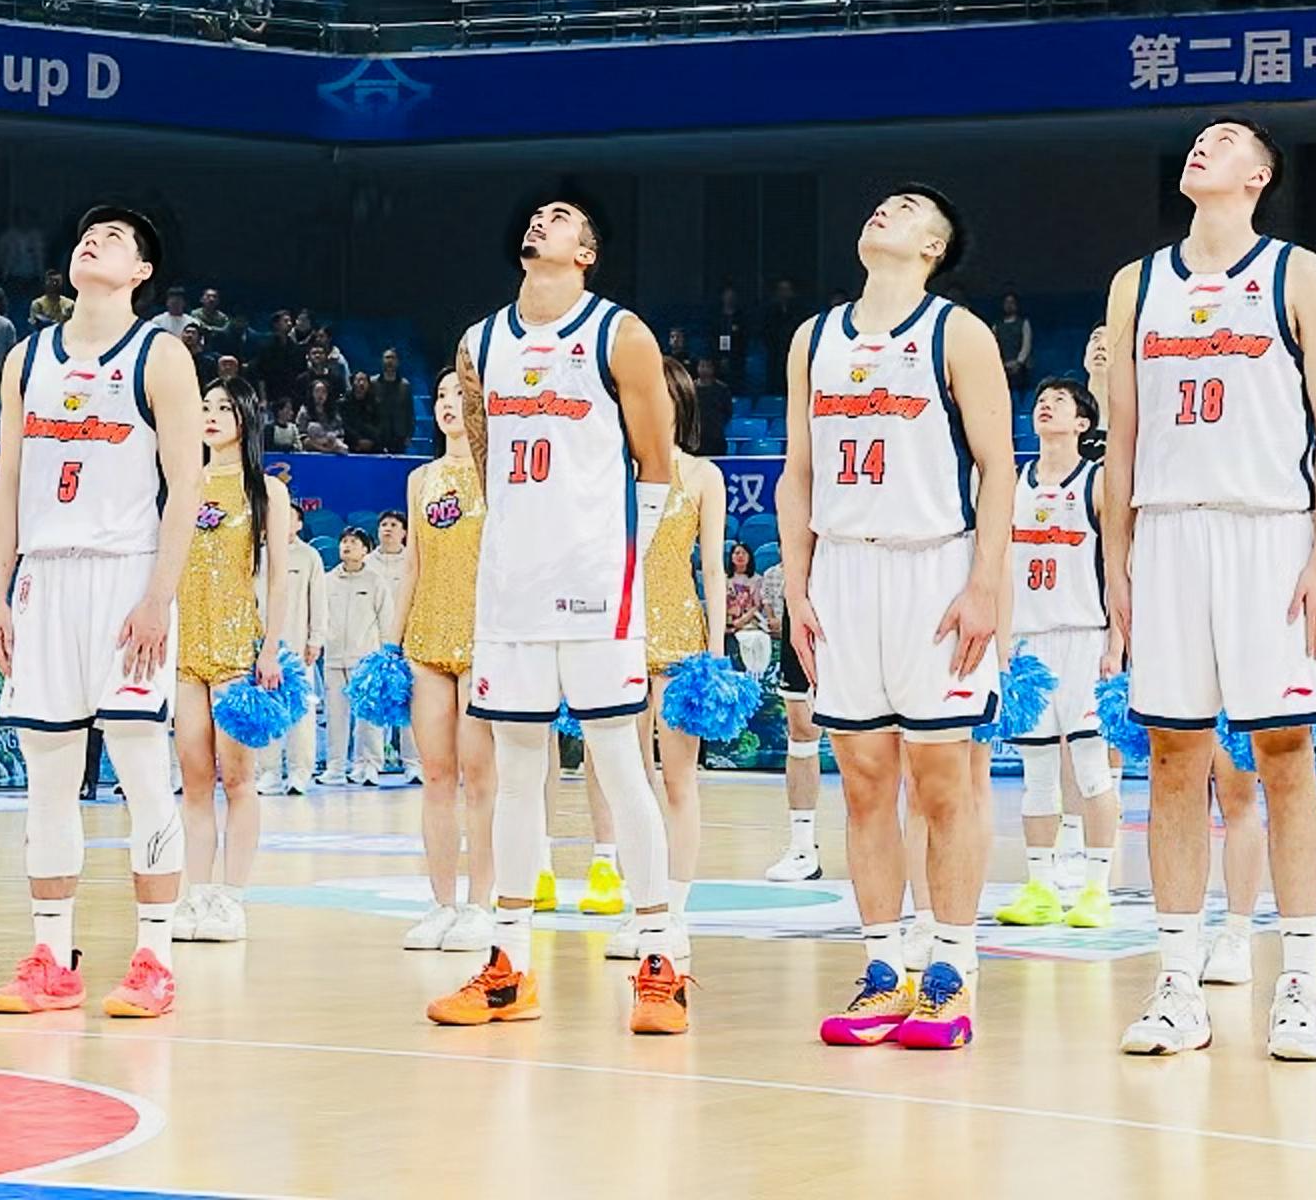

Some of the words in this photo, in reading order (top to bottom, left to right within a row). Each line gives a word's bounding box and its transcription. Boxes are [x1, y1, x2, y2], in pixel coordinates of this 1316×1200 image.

[88, 53, 121, 99] D
[1175, 377, 1225, 425] 18
[58, 461, 83, 503] 5
[508, 438, 551, 484] 10
[837, 439, 885, 485] 14
[727, 473, 765, 514] 汉
[1027, 558, 1057, 591] 33
